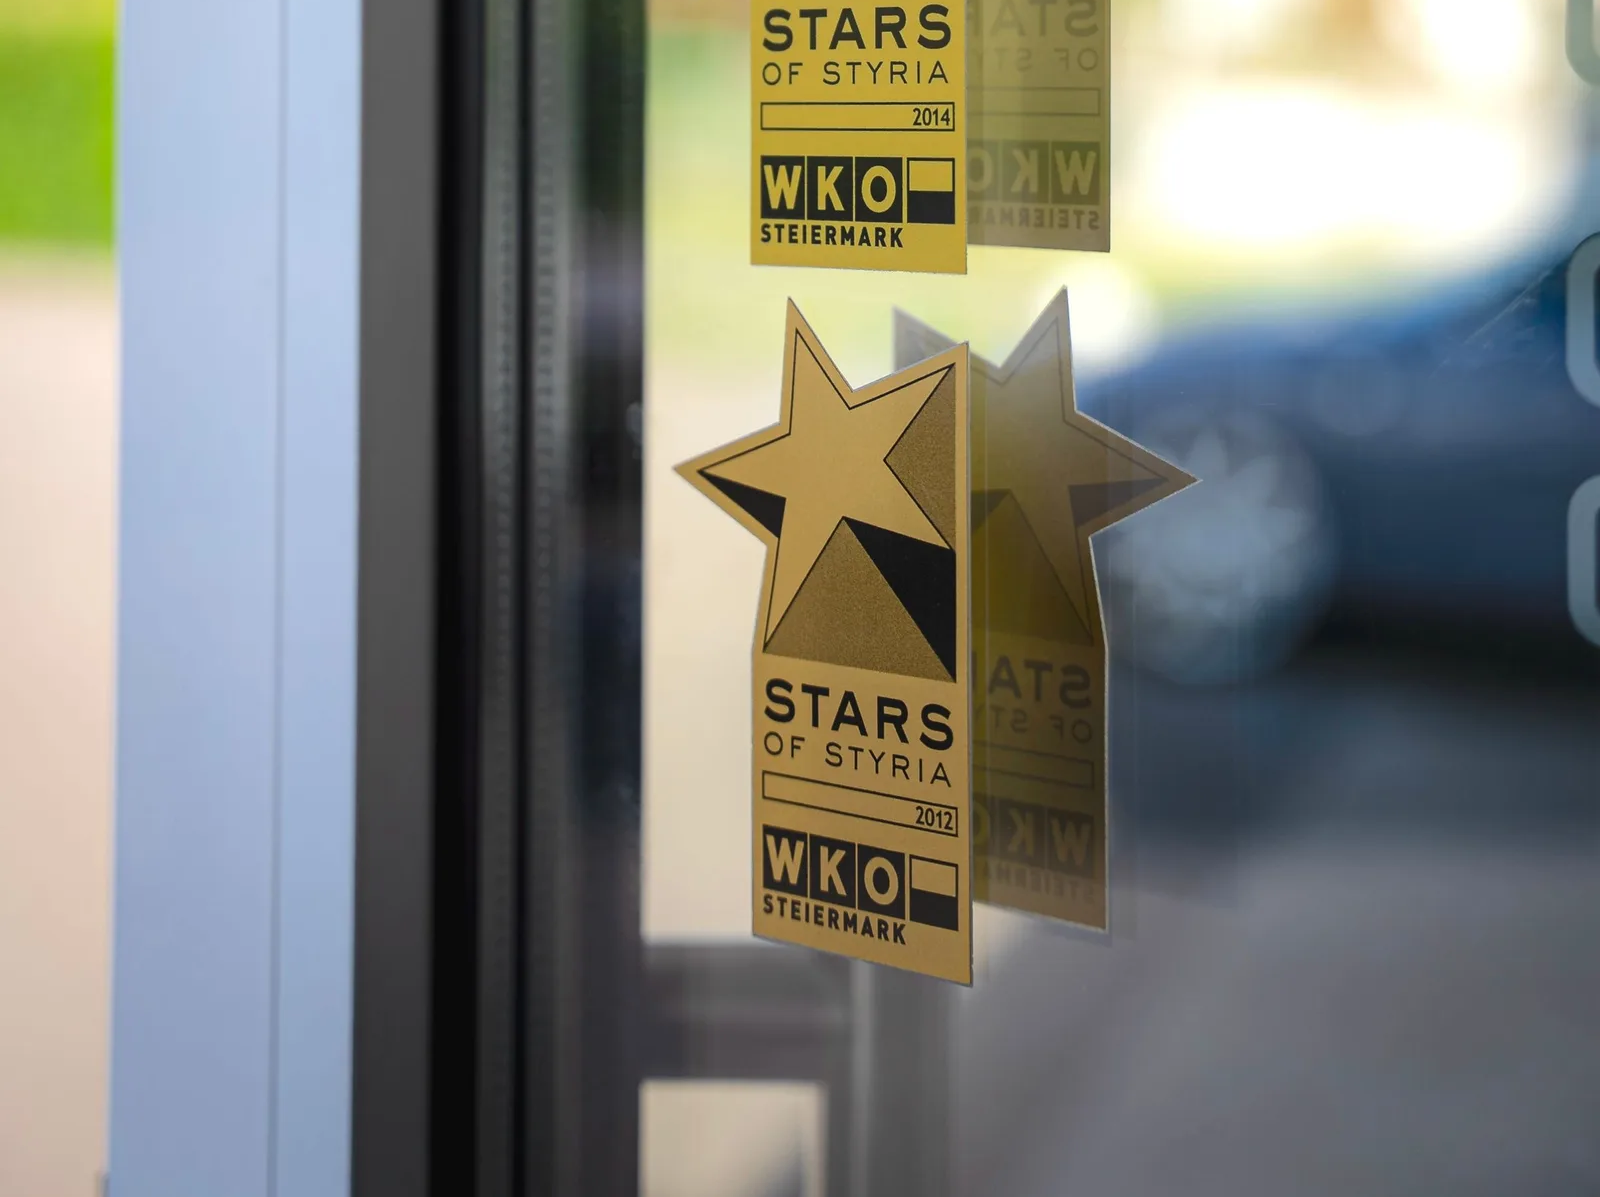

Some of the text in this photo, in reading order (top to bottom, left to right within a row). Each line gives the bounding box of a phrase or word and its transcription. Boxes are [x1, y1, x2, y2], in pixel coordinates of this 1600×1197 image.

[762, 3, 952, 52] STARS
[762, 60, 949, 86] OF STYRIA
[912, 107, 951, 127] 2014
[763, 163, 896, 214] WKO
[760, 223, 904, 248] STEIERMARK
[764, 678, 954, 751] STARS
[764, 731, 952, 788] OF STYRIA
[915, 806, 953, 831] 2012
[766, 833, 899, 906] WKO
[763, 893, 906, 945] STEIERMARK
